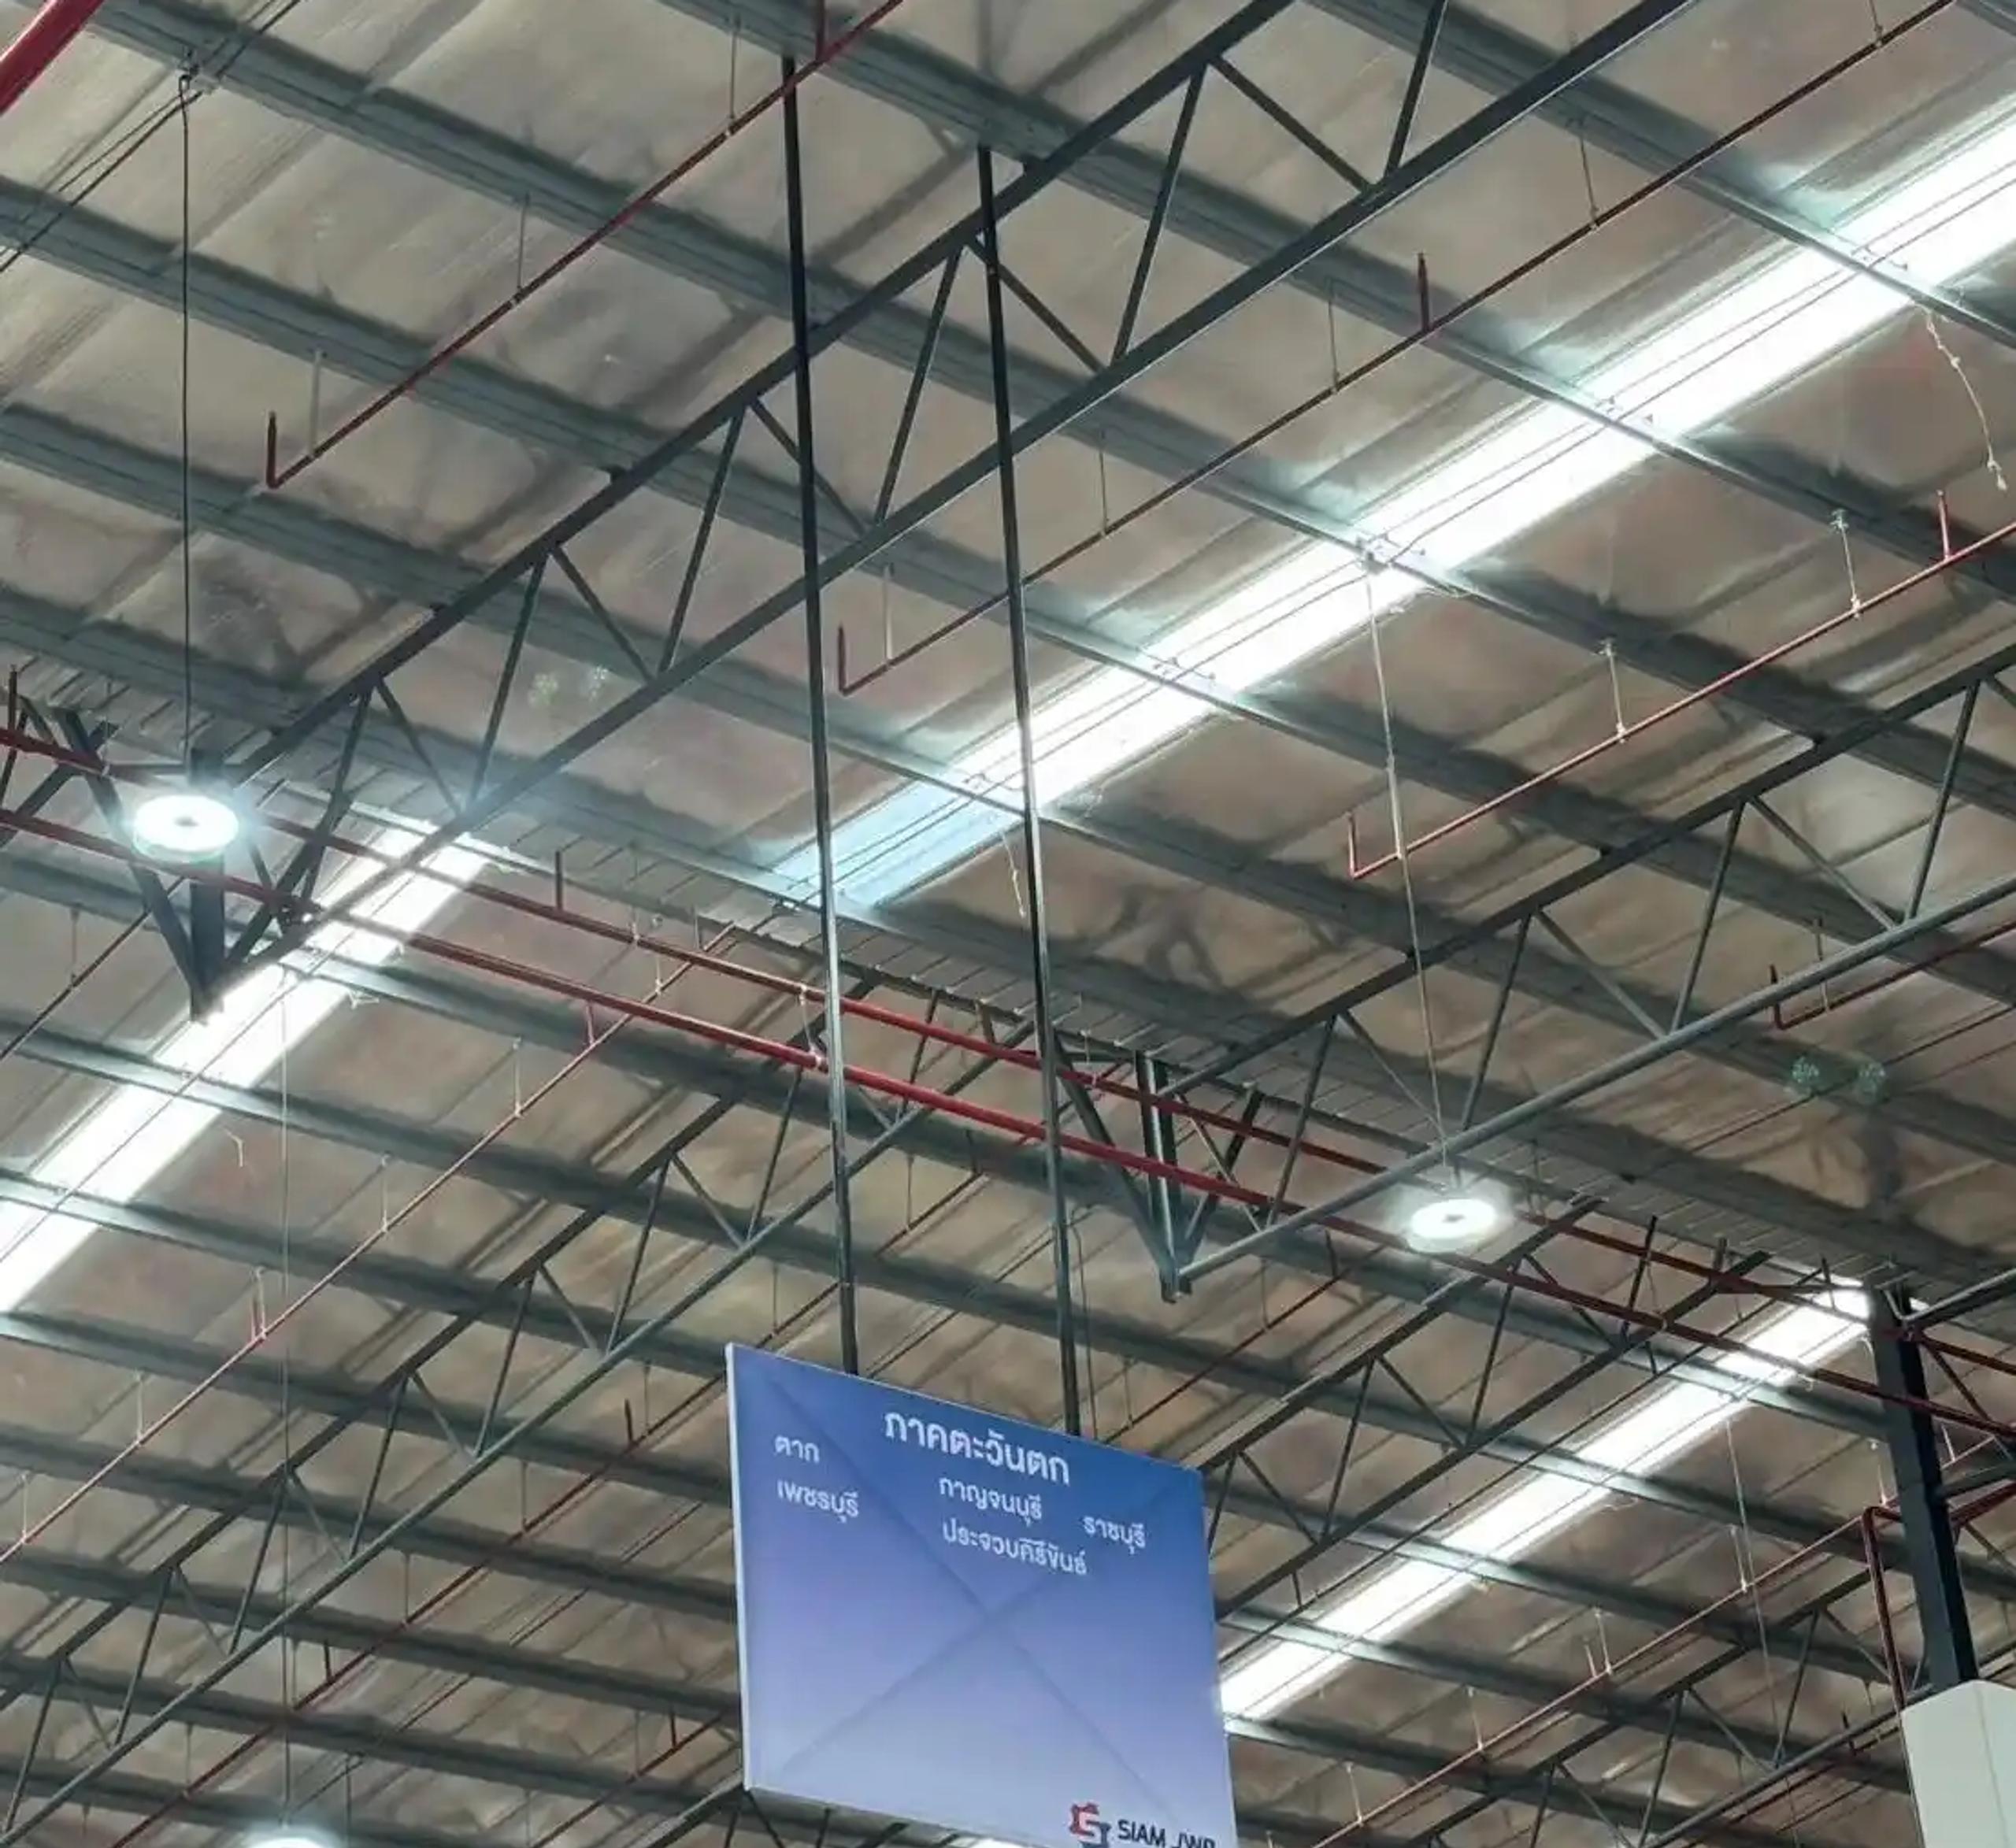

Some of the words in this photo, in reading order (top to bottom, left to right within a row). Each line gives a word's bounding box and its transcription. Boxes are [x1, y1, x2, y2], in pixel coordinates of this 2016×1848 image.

[774, 1435, 820, 1464] ตาก
[884, 1410, 1069, 1487] ภาคตะวันตก
[777, 1479, 859, 1524] เพชรบุรี
[939, 1476, 1043, 1528] กาญจนบุรี
[1117, 1819, 1166, 1848] SIAM
